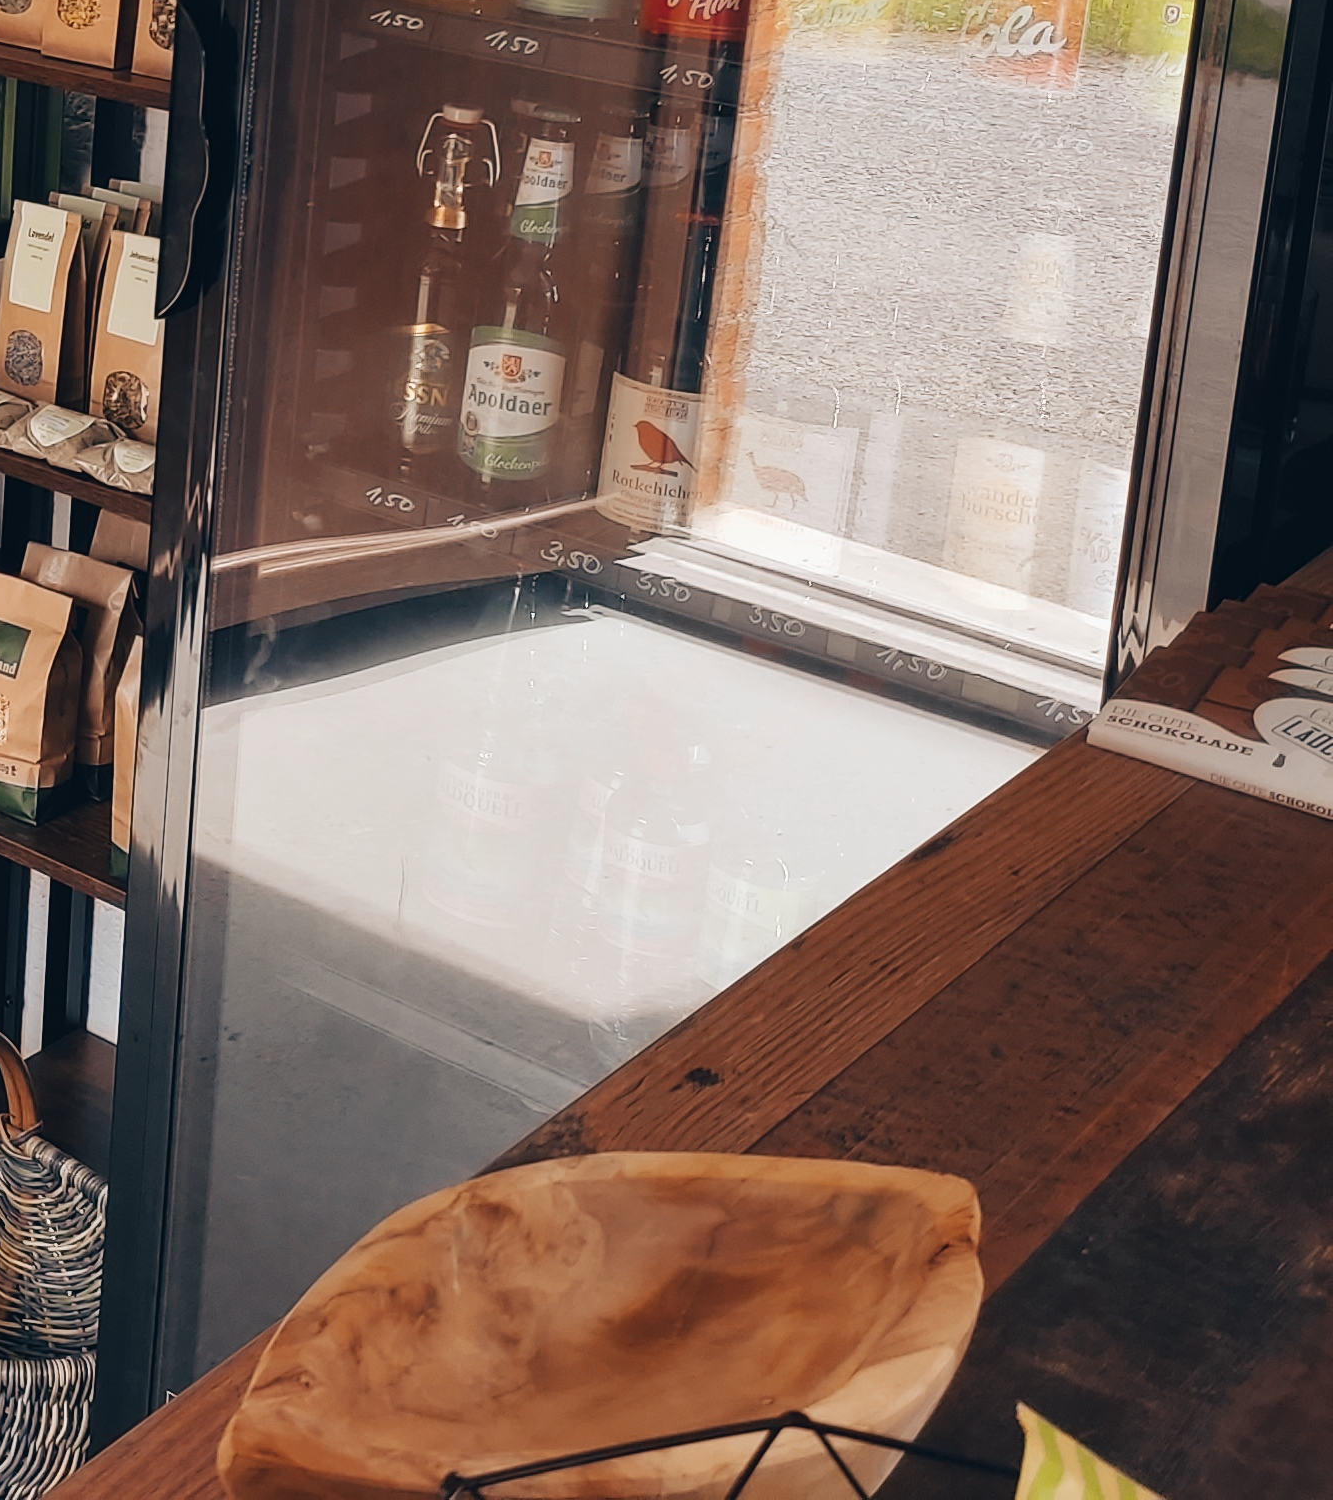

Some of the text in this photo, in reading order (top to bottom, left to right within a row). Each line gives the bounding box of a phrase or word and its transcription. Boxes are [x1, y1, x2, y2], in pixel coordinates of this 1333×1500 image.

[370, 9, 424, 31] 1,50
[485, 30, 539, 55] 1,50
[659, 63, 714, 90] 1,50
[523, 174, 568, 191] poldaer
[468, 383, 553, 416] Apoldaer
[613, 469, 702, 500] Rotkehlchen
[365, 486, 415, 514] 1,50
[540, 540, 604, 576] 3,50
[876, 645, 948, 682] 1,50
[1037, 697, 1085, 726] 1,5
[1112, 705, 1200, 732] DIE GUTE
[1106, 714, 1254, 757] SCHOKOLADE
